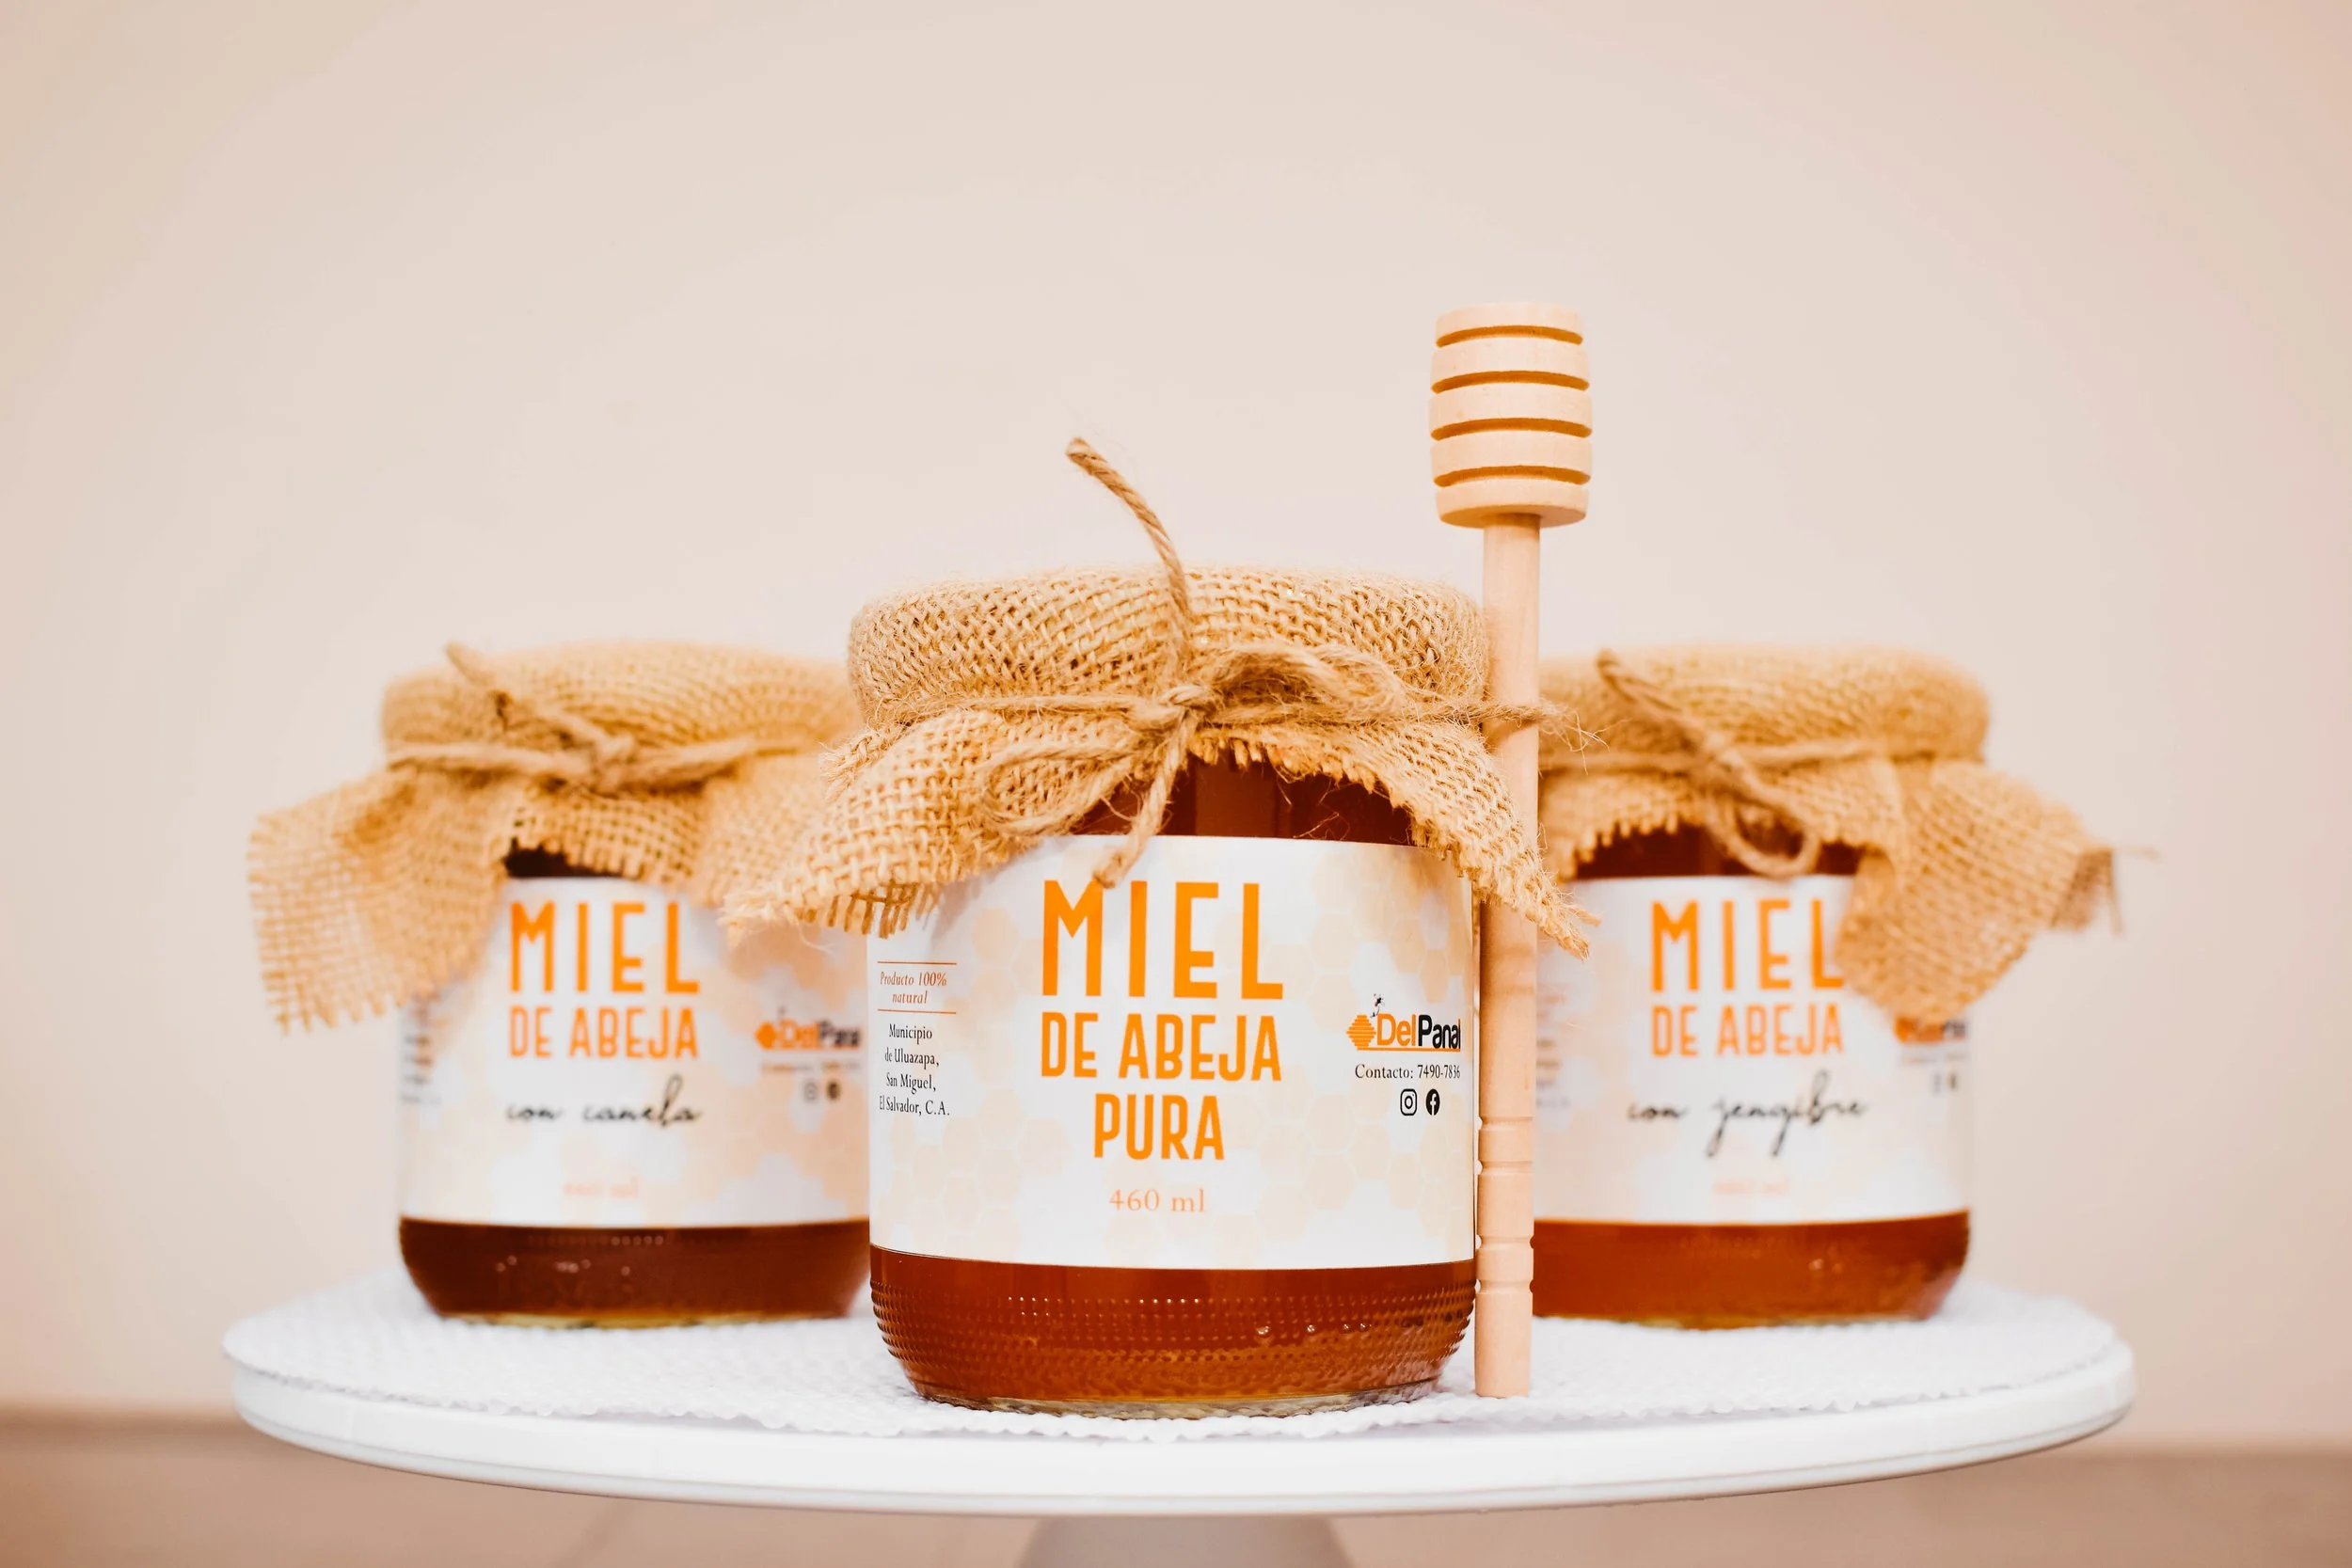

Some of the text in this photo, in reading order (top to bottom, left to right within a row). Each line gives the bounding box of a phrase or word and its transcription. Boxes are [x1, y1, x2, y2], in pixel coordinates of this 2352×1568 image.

[510, 901, 701, 994] MIEL
[1042, 880, 1283, 999] MIEL
[1651, 898, 1844, 992] MIEL
[880, 972, 947, 987] Producto 100%
[892, 990, 928, 1005] natural
[509, 1006, 700, 1060] DE ABEJA
[889, 1023, 933, 1045] Municipio
[1041, 1011, 1281, 1082] DE ABEJA
[1651, 1003, 1844, 1057] DE ABEJA
[884, 1047, 940, 1069] de Uluazapa,
[886, 1072, 937, 1095] San Miguel,
[1355, 1064, 1461, 1080] Contacto: 7490-7836
[506, 1074, 704, 1127] con canela
[880, 1096, 885, 1111] El
[886, 1096, 922, 1117] Salvador,
[1094, 1093, 1225, 1161] PURA
[1627, 1070, 1872, 1158] con jengibre
[1109, 1189, 1207, 1213] 460 ml
